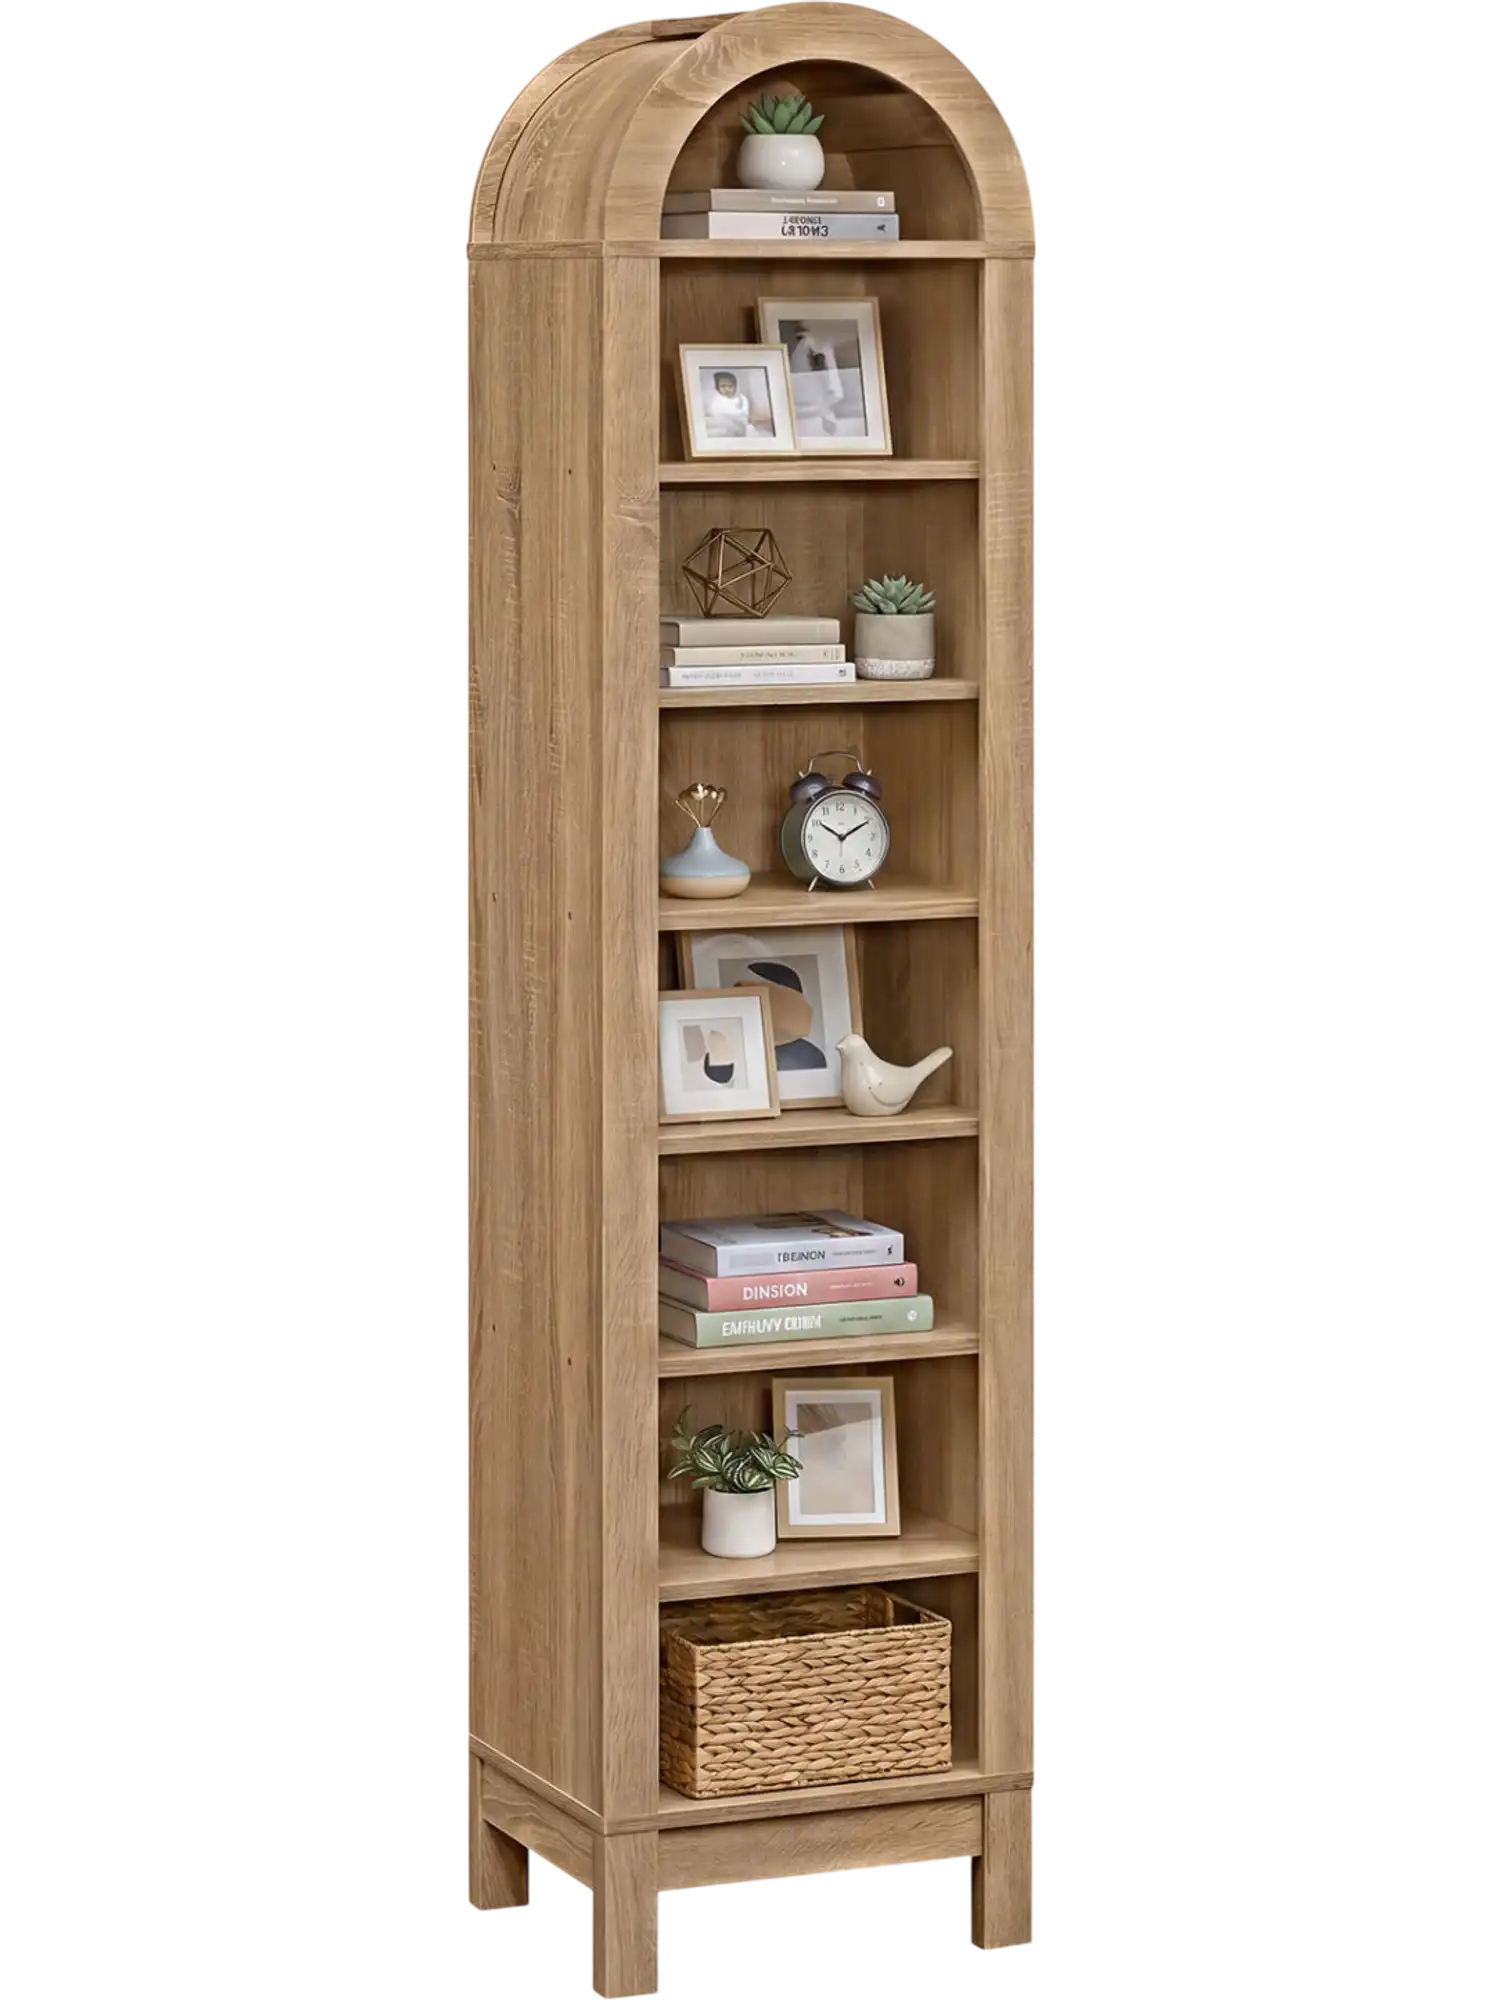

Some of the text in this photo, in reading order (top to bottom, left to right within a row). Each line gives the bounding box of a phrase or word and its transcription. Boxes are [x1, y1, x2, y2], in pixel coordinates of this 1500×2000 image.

[836, 802, 845, 811] 12
[839, 865, 846, 874] 6
[744, 1283, 808, 1301] DINSION
